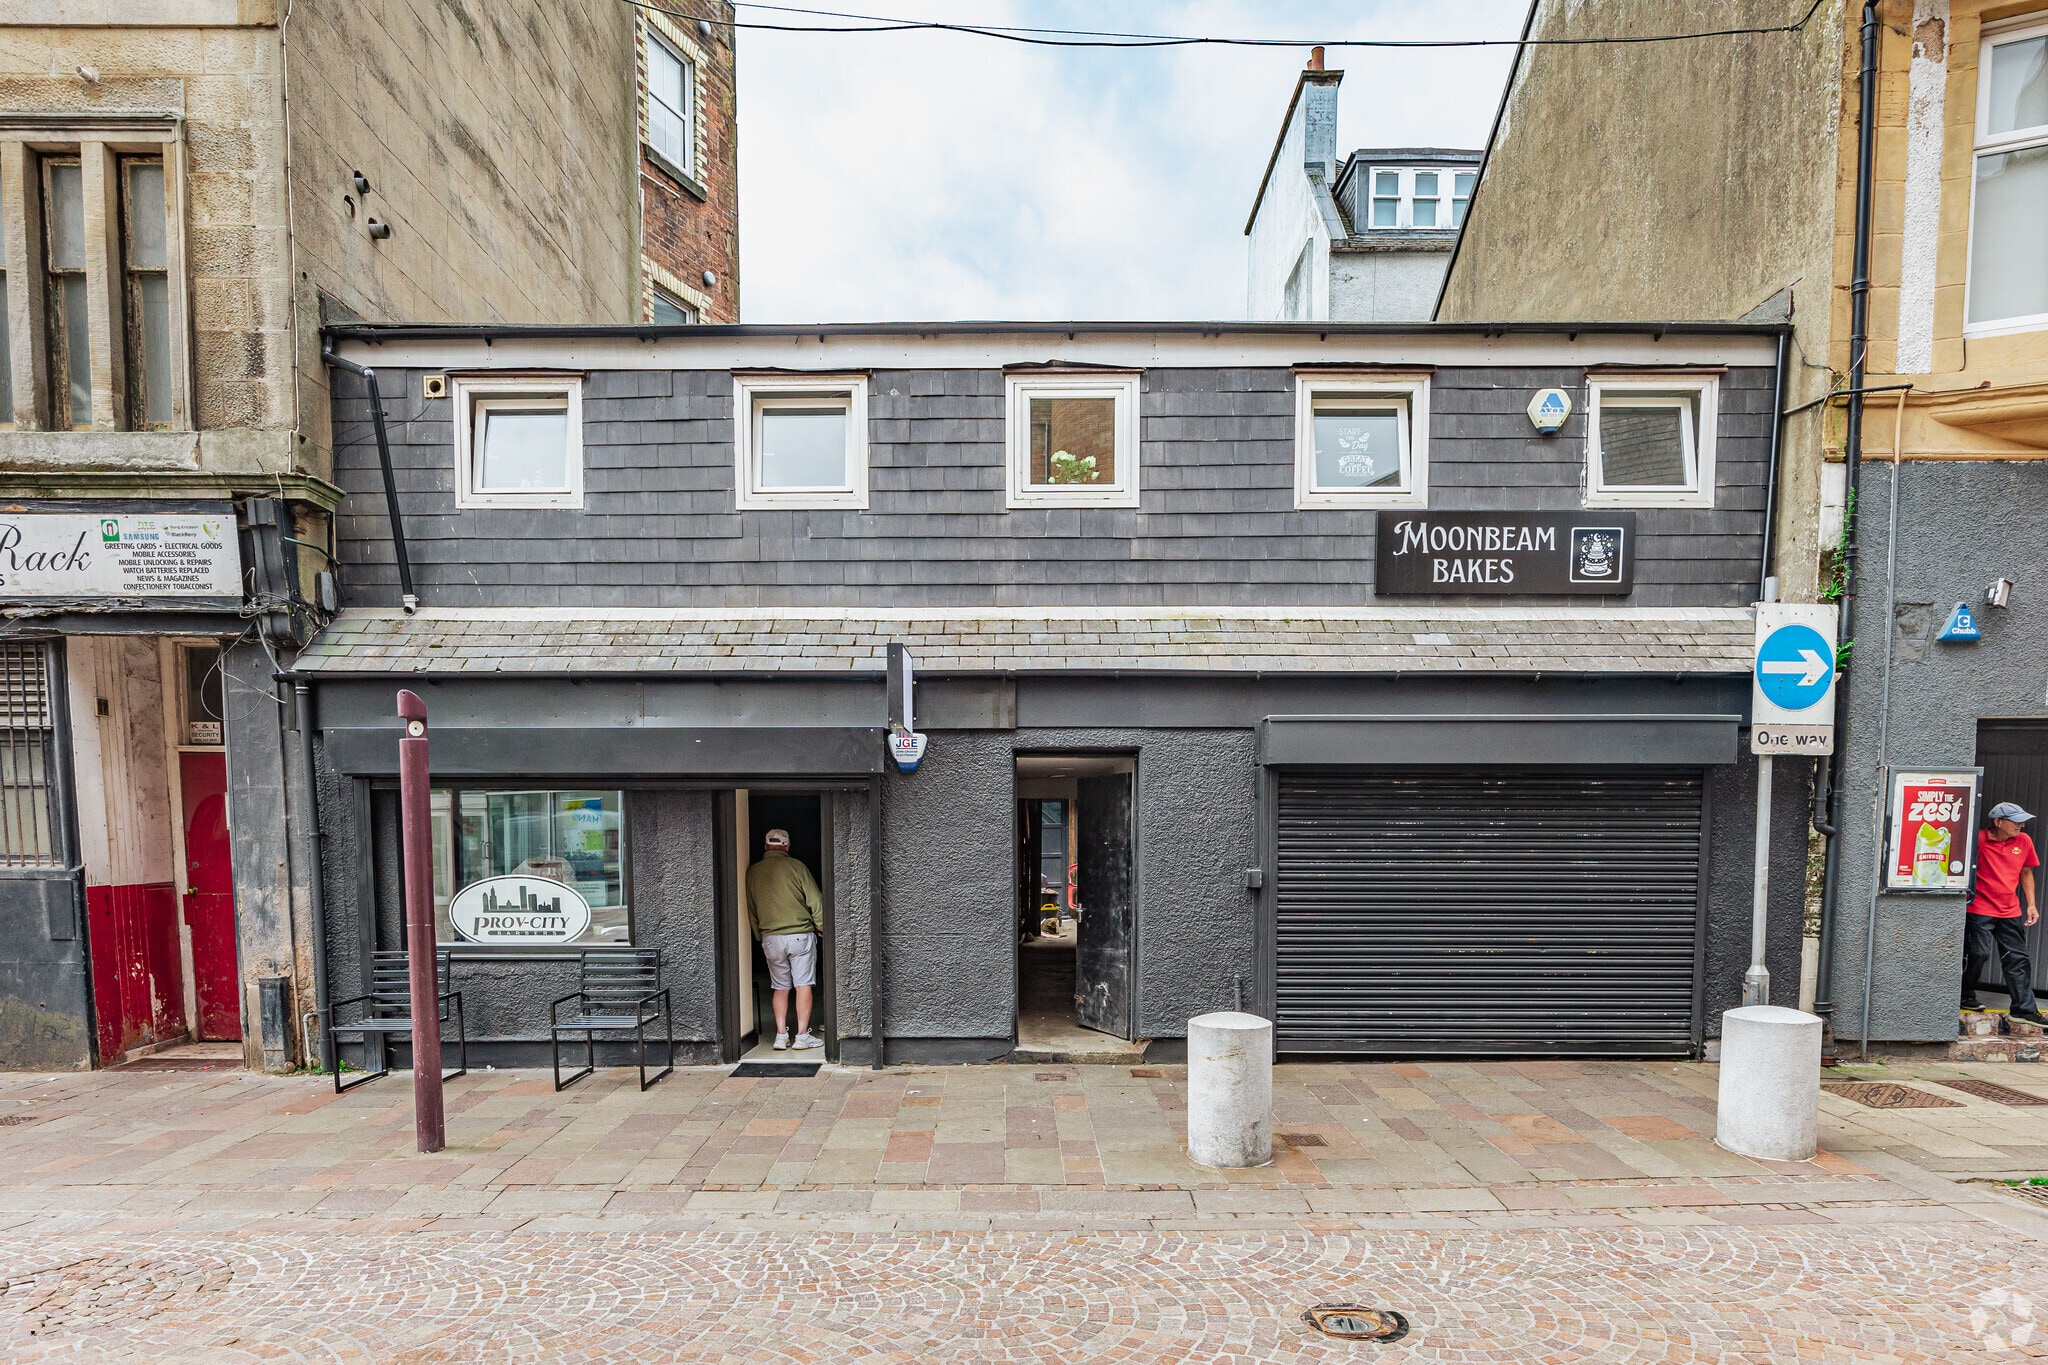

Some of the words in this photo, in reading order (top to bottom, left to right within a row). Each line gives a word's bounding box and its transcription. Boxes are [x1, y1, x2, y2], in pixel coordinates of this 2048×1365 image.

[1351, 440, 1368, 452] Day
[0, 523, 92, 571] Rack
[1393, 520, 1556, 556] MOONBEAM
[1433, 559, 1514, 583] BAKES
[896, 739, 918, 747] JGE
[1758, 731, 1788, 745] One
[1795, 736, 1827, 747] way
[1918, 791, 1944, 802] SIMPLY
[1944, 794, 1954, 802] THE
[1908, 798, 1963, 822] zest
